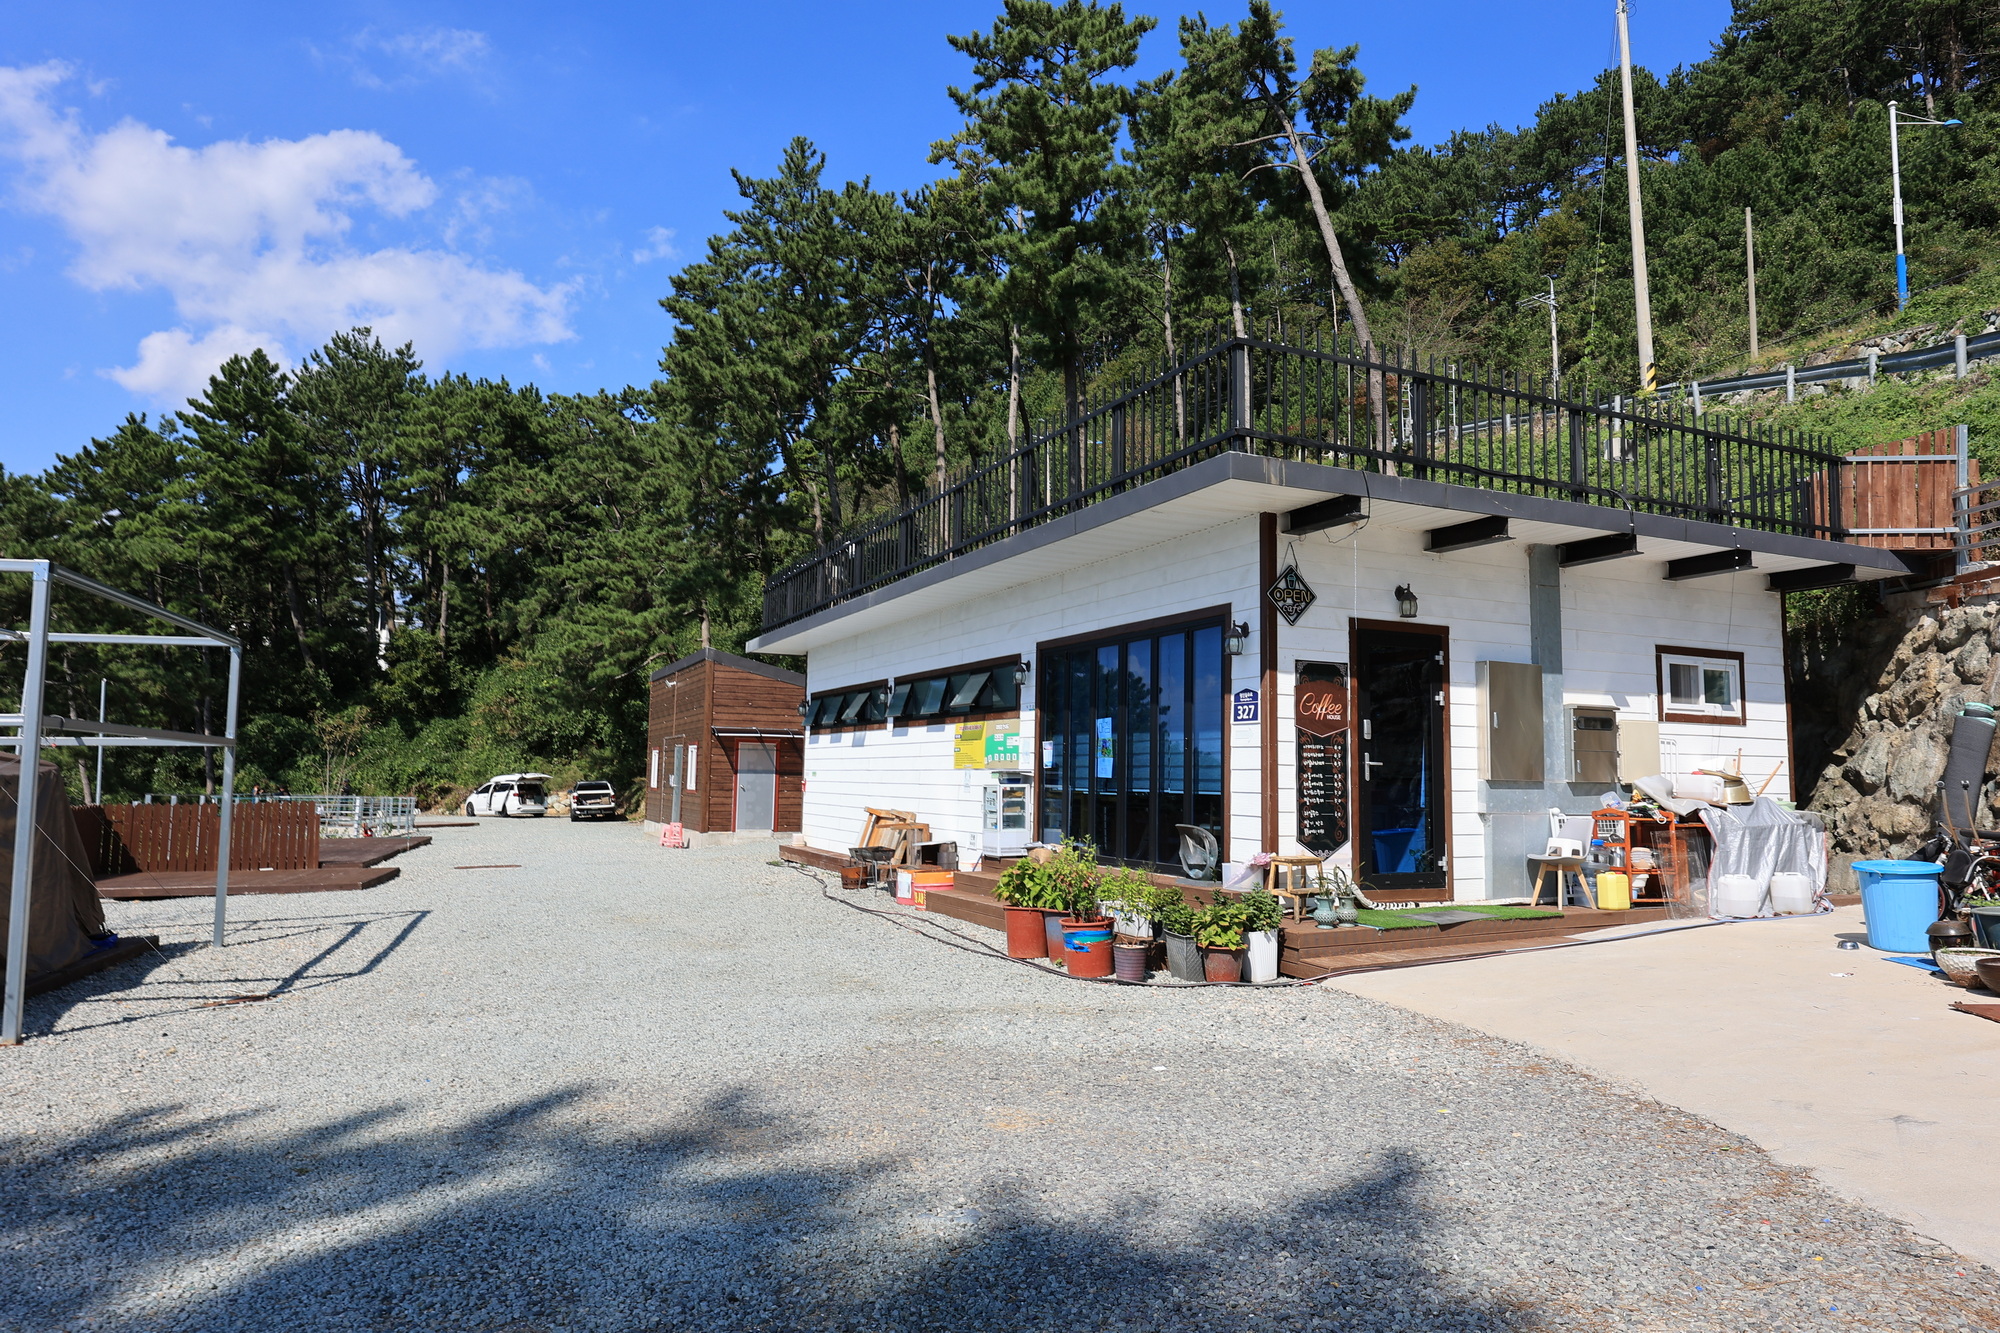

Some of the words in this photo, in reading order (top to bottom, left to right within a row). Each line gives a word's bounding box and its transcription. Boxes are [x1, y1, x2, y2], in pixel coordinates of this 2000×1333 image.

[1273, 588, 1311, 603] OPEN
[1282, 603, 1302, 615] cafe
[1236, 704, 1255, 720] 327
[1300, 692, 1343, 720] Coffee
